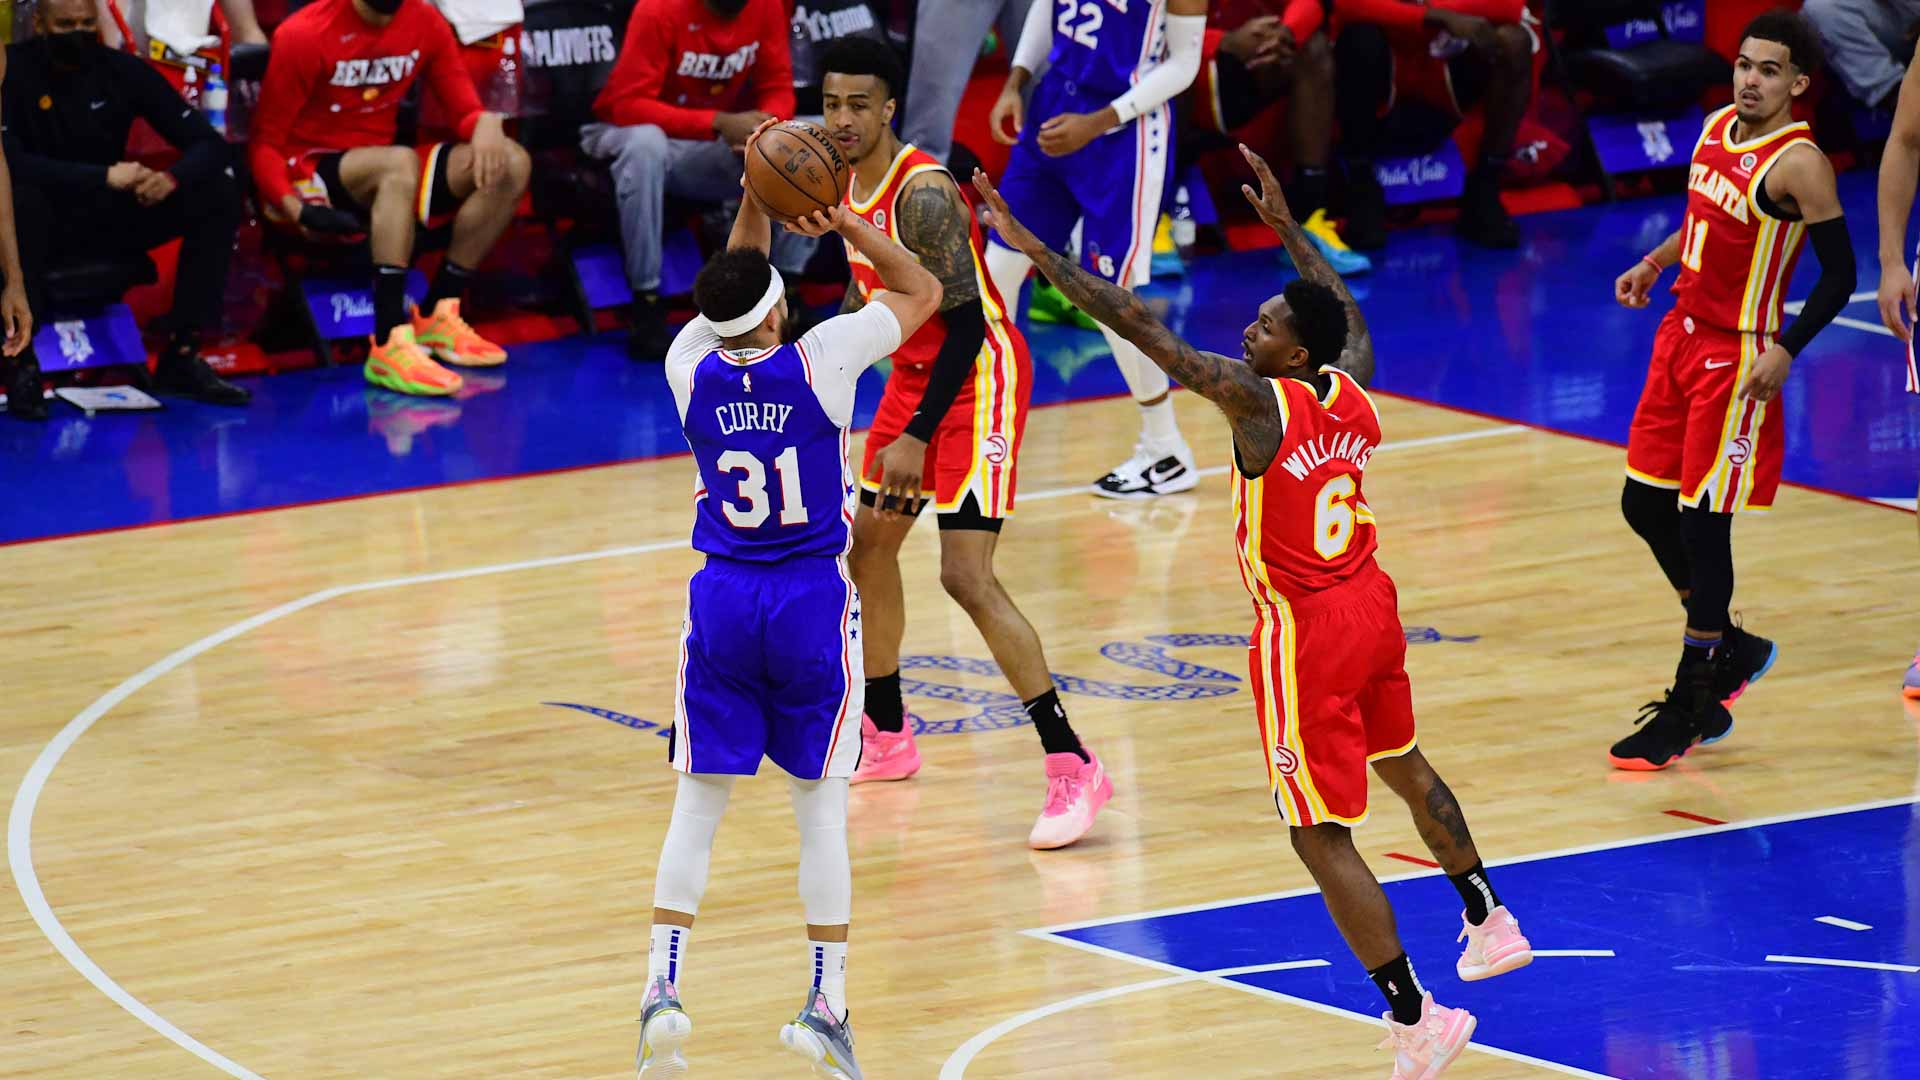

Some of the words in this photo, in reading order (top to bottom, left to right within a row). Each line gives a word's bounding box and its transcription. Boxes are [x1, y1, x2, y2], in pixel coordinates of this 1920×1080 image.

[533, 25, 616, 67] PLAYOFFS
[1057, 0, 1104, 50] 22
[1681, 212, 1710, 273] 11
[715, 402, 793, 436] CURRY
[1281, 431, 1376, 482] WILLIAMS
[716, 446, 809, 529] 31
[1313, 472, 1357, 562] 6
